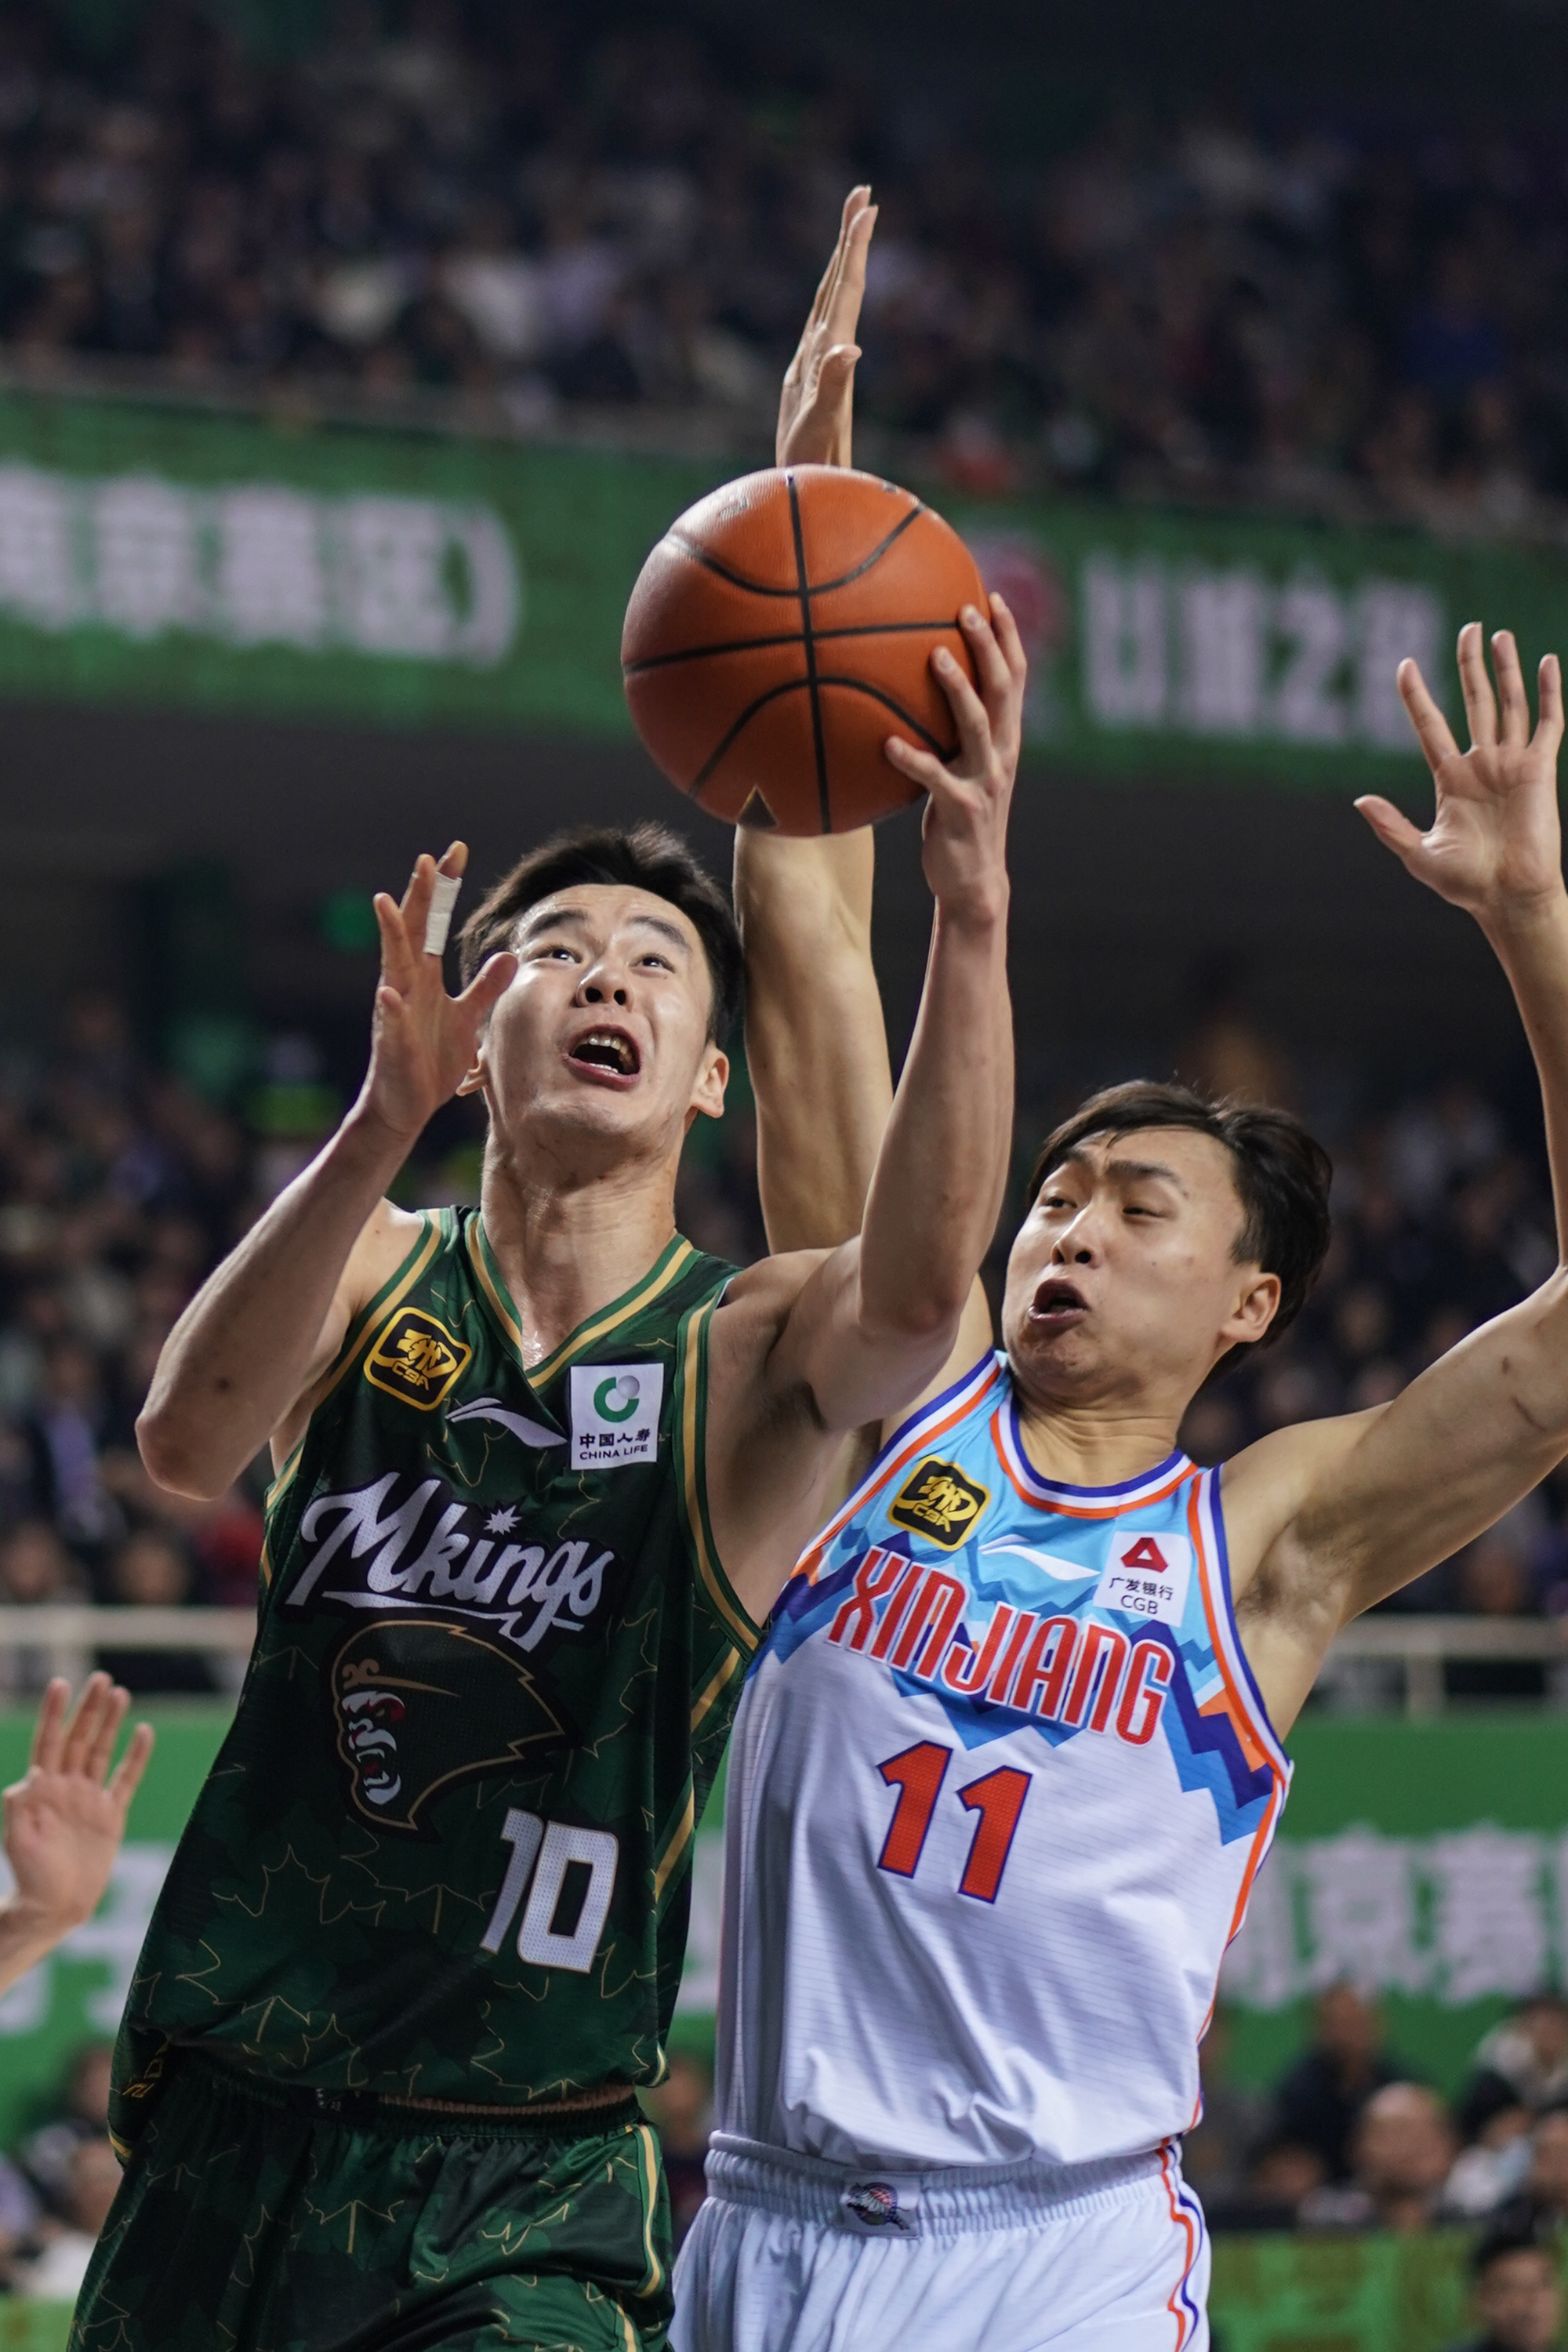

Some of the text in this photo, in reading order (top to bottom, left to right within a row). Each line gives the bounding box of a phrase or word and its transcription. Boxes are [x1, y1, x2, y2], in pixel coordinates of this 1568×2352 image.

[392, 1360, 429, 1391] CBA
[579, 1428, 650, 1449] 中国人寿
[579, 1444, 648, 1460] CHINA LIFE
[913, 1503, 951, 1533] CBA
[285, 1472, 615, 1653] Mkings
[1109, 1577, 1174, 1601] 广发银行
[1121, 1595, 1159, 1615] CGB
[827, 1545, 1176, 1748] XINJIANG
[877, 1740, 1033, 1904] 11
[479, 1806, 619, 1974] 10
